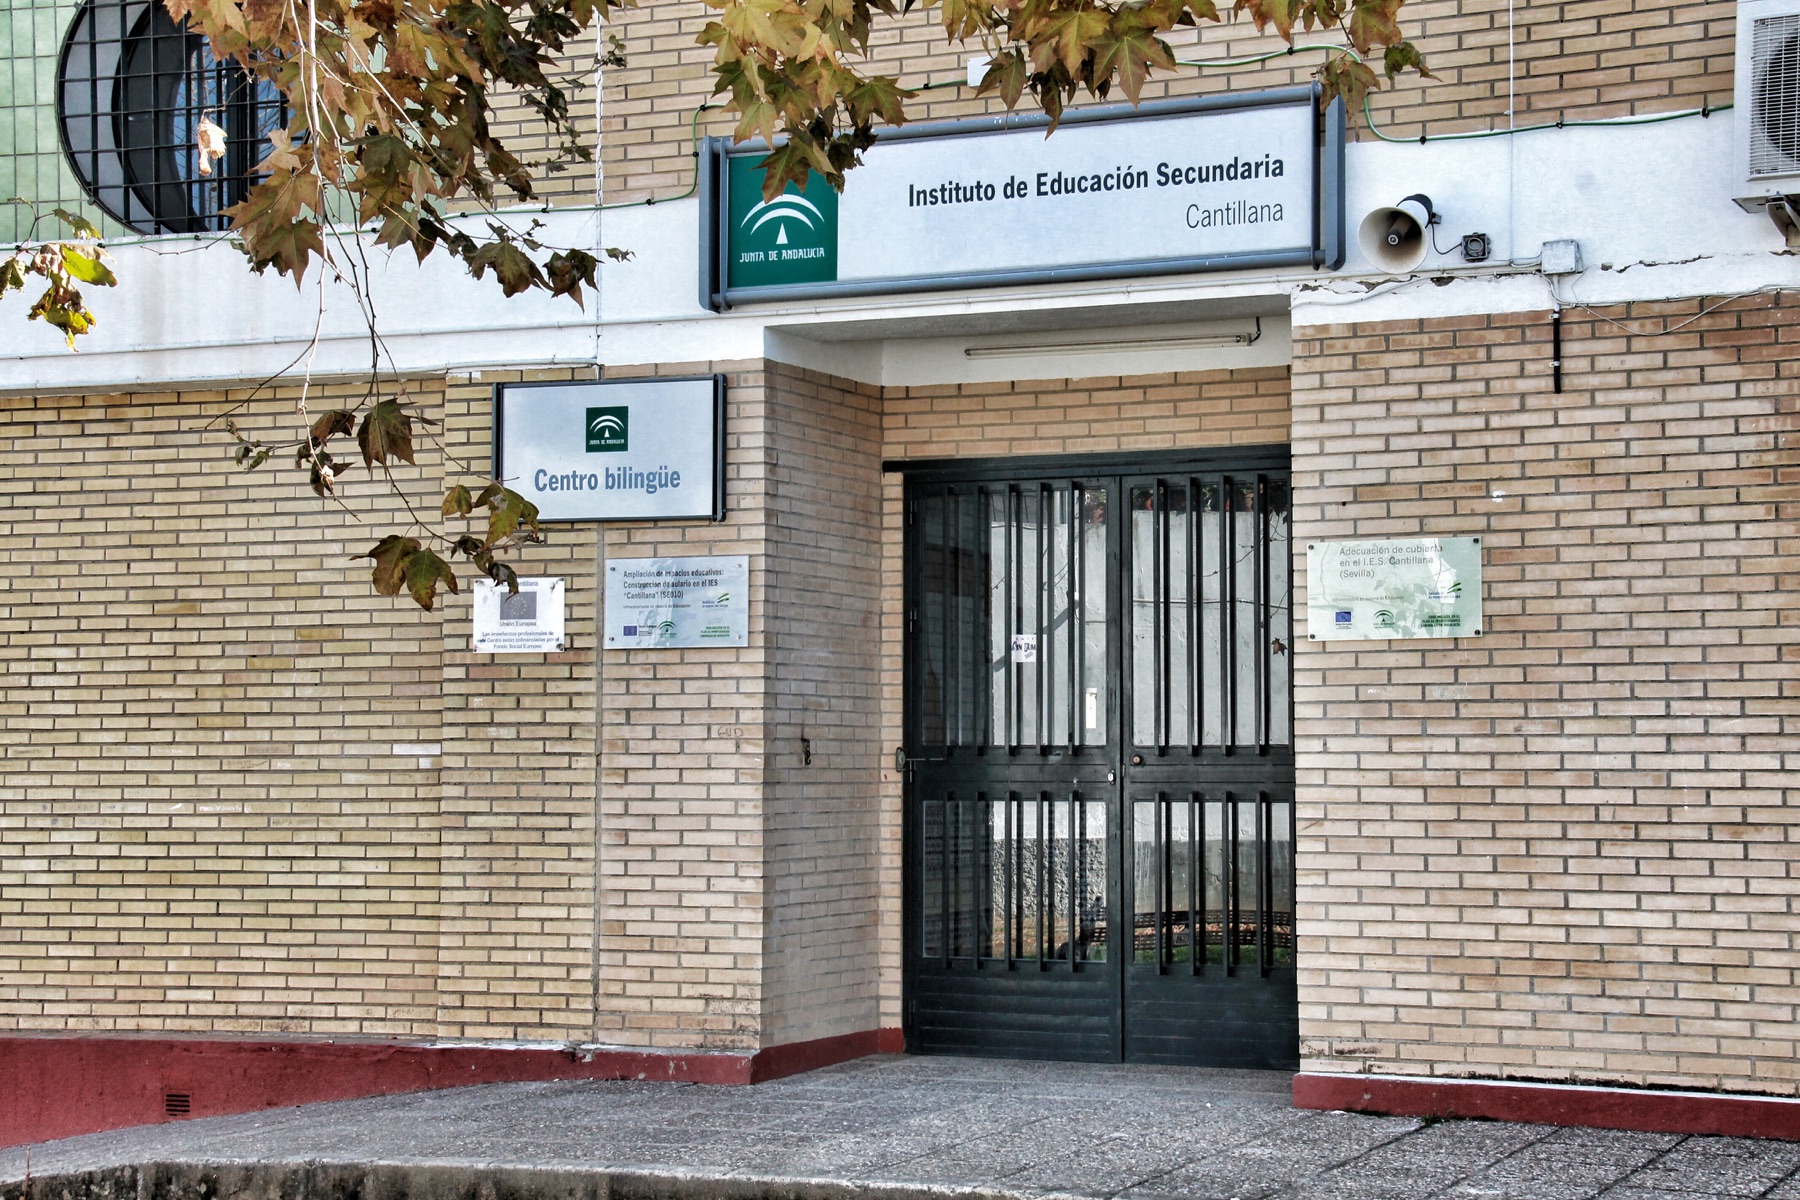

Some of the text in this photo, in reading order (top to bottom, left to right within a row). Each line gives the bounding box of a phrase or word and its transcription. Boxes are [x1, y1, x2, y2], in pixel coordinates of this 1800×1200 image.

[908, 153, 1285, 207] Instituto de Educación Secundaria
[1186, 200, 1284, 229] Cantillana
[739, 251, 765, 263] JUNTA
[768, 250, 778, 261] DE
[534, 465, 681, 494] Centro bilingüe
[1339, 543, 1443, 556] Adecuación de cubierta
[1353, 558, 1360, 566] el
[1388, 556, 1434, 566] Cantillana
[623, 570, 655, 579] Ampliación
[665, 569, 690, 578] espacios
[691, 568, 724, 577] educativos:
[1339, 569, 1375, 580] (Sevilla)
[623, 580, 661, 589] Construcción
[662, 580, 670, 588] de
[671, 580, 691, 588] aulario
[701, 579, 707, 587] el
[708, 579, 718, 587] IES
